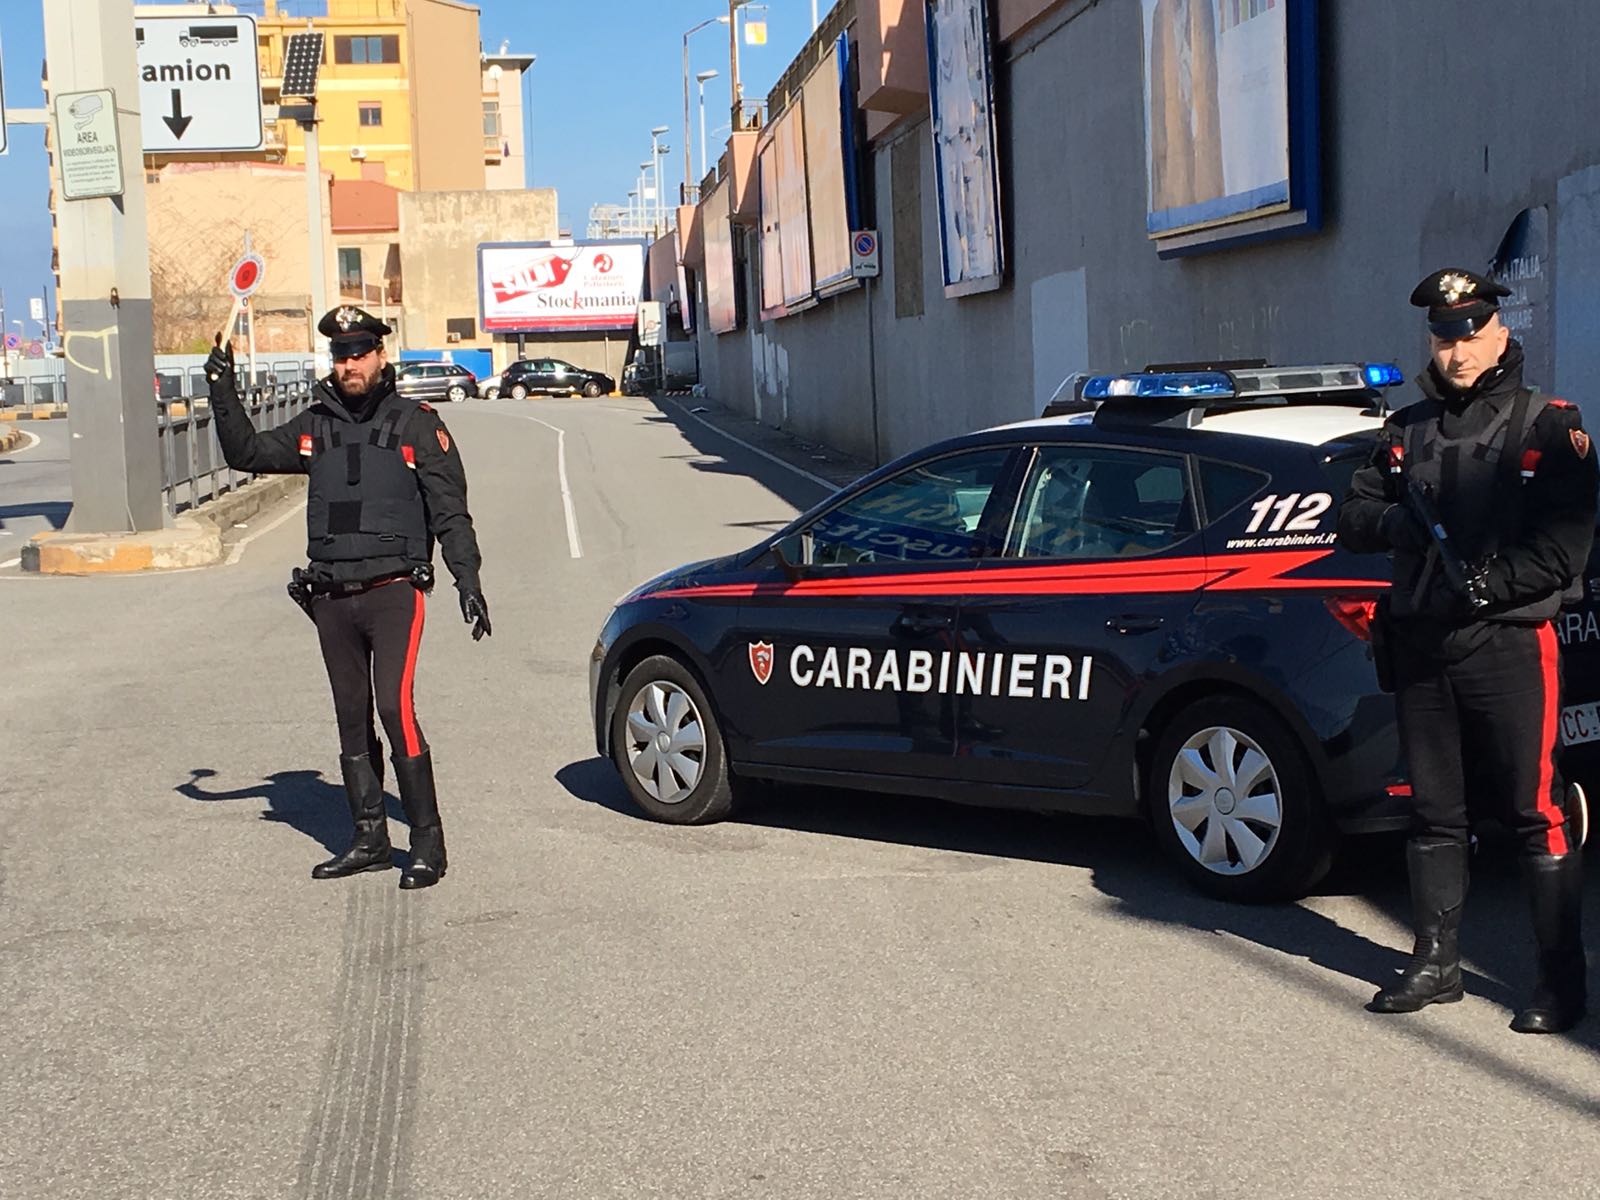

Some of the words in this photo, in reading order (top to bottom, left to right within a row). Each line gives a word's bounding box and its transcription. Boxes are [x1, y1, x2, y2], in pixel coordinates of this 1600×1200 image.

[141, 58, 231, 82] amion
[77, 132, 98, 143] AREA
[503, 261, 557, 295] SALDI
[537, 289, 636, 310] Stockmania
[1244, 492, 1333, 534] 112
[1226, 533, 1338, 549] www.carabinieri.it
[789, 643, 1093, 701] CARABINIERI
